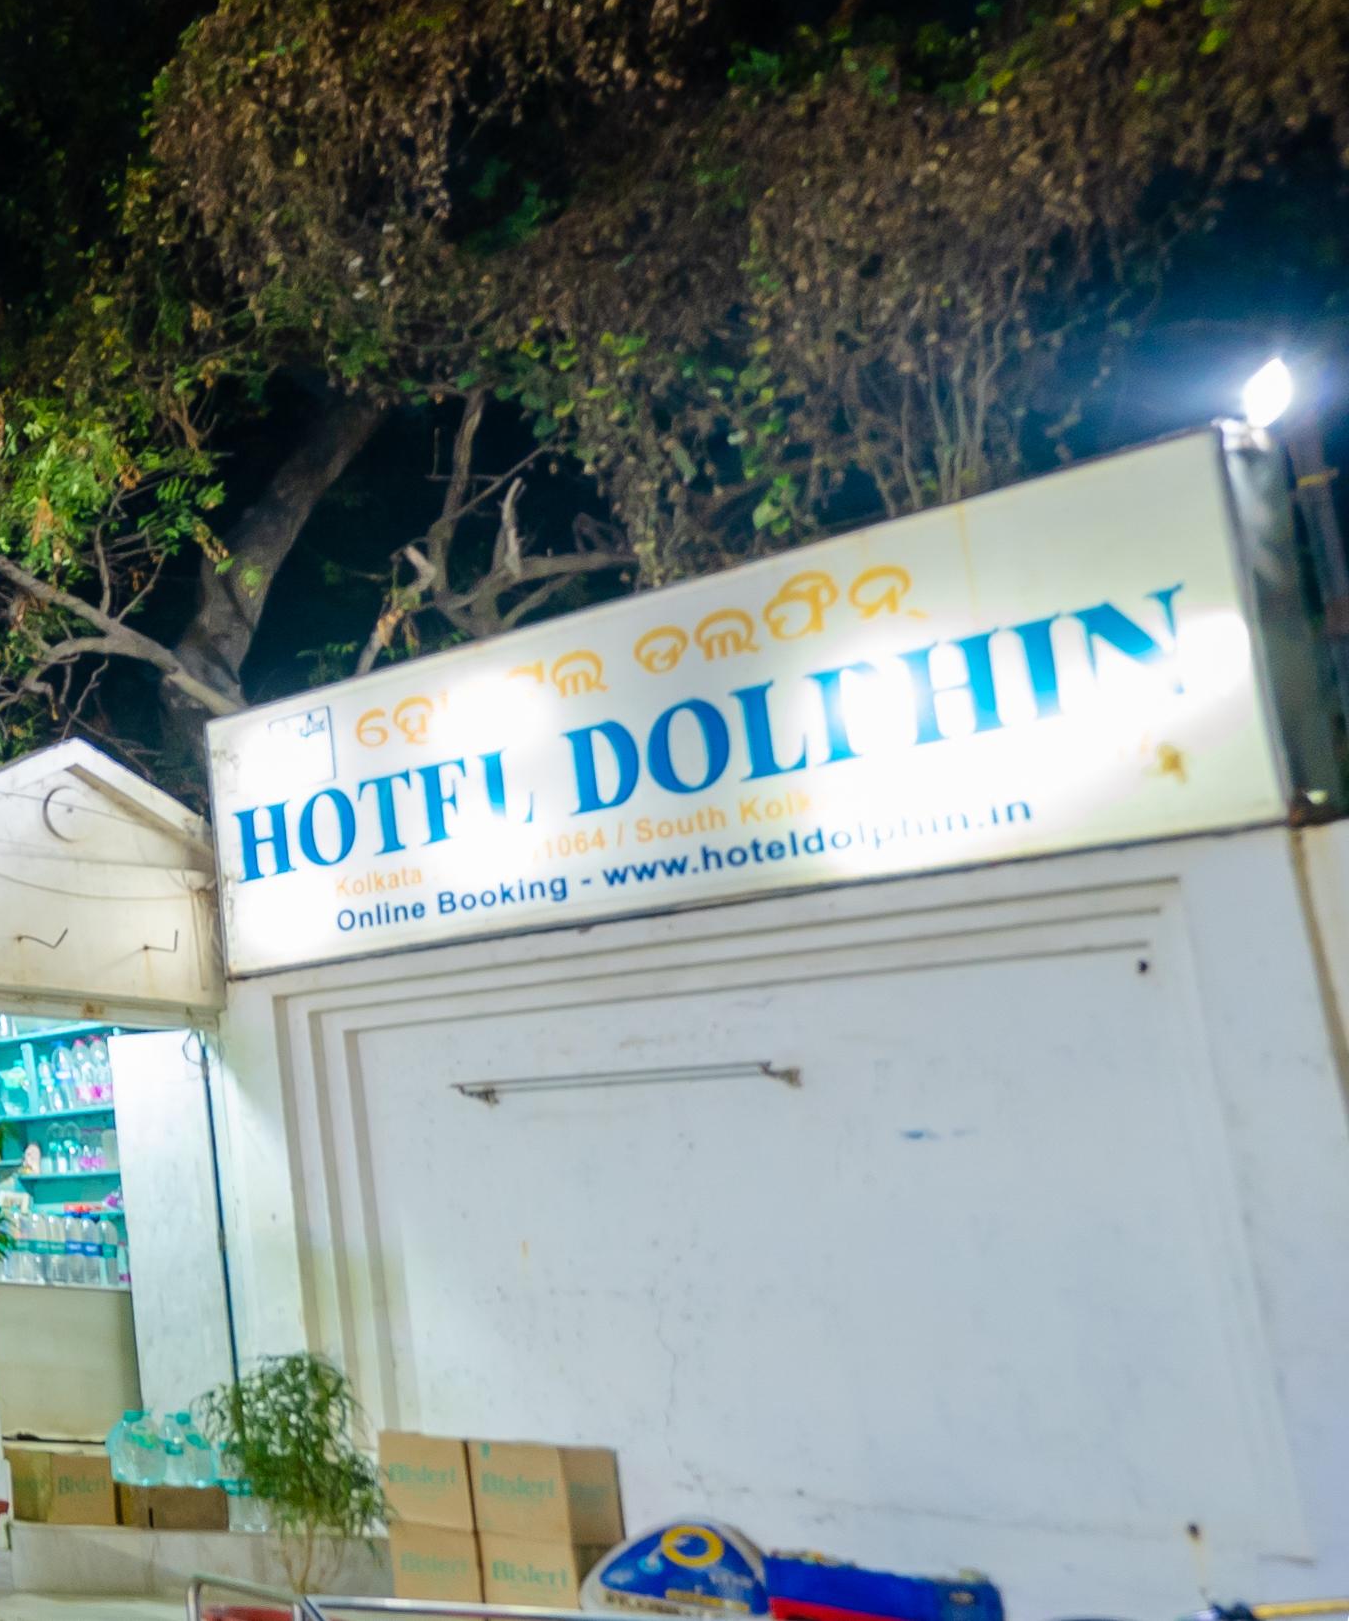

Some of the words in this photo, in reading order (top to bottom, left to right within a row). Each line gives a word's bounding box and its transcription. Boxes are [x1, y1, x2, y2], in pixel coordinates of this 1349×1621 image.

[634, 805, 727, 844] South
[336, 900, 426, 932] Online
[437, 875, 569, 916] Booking
